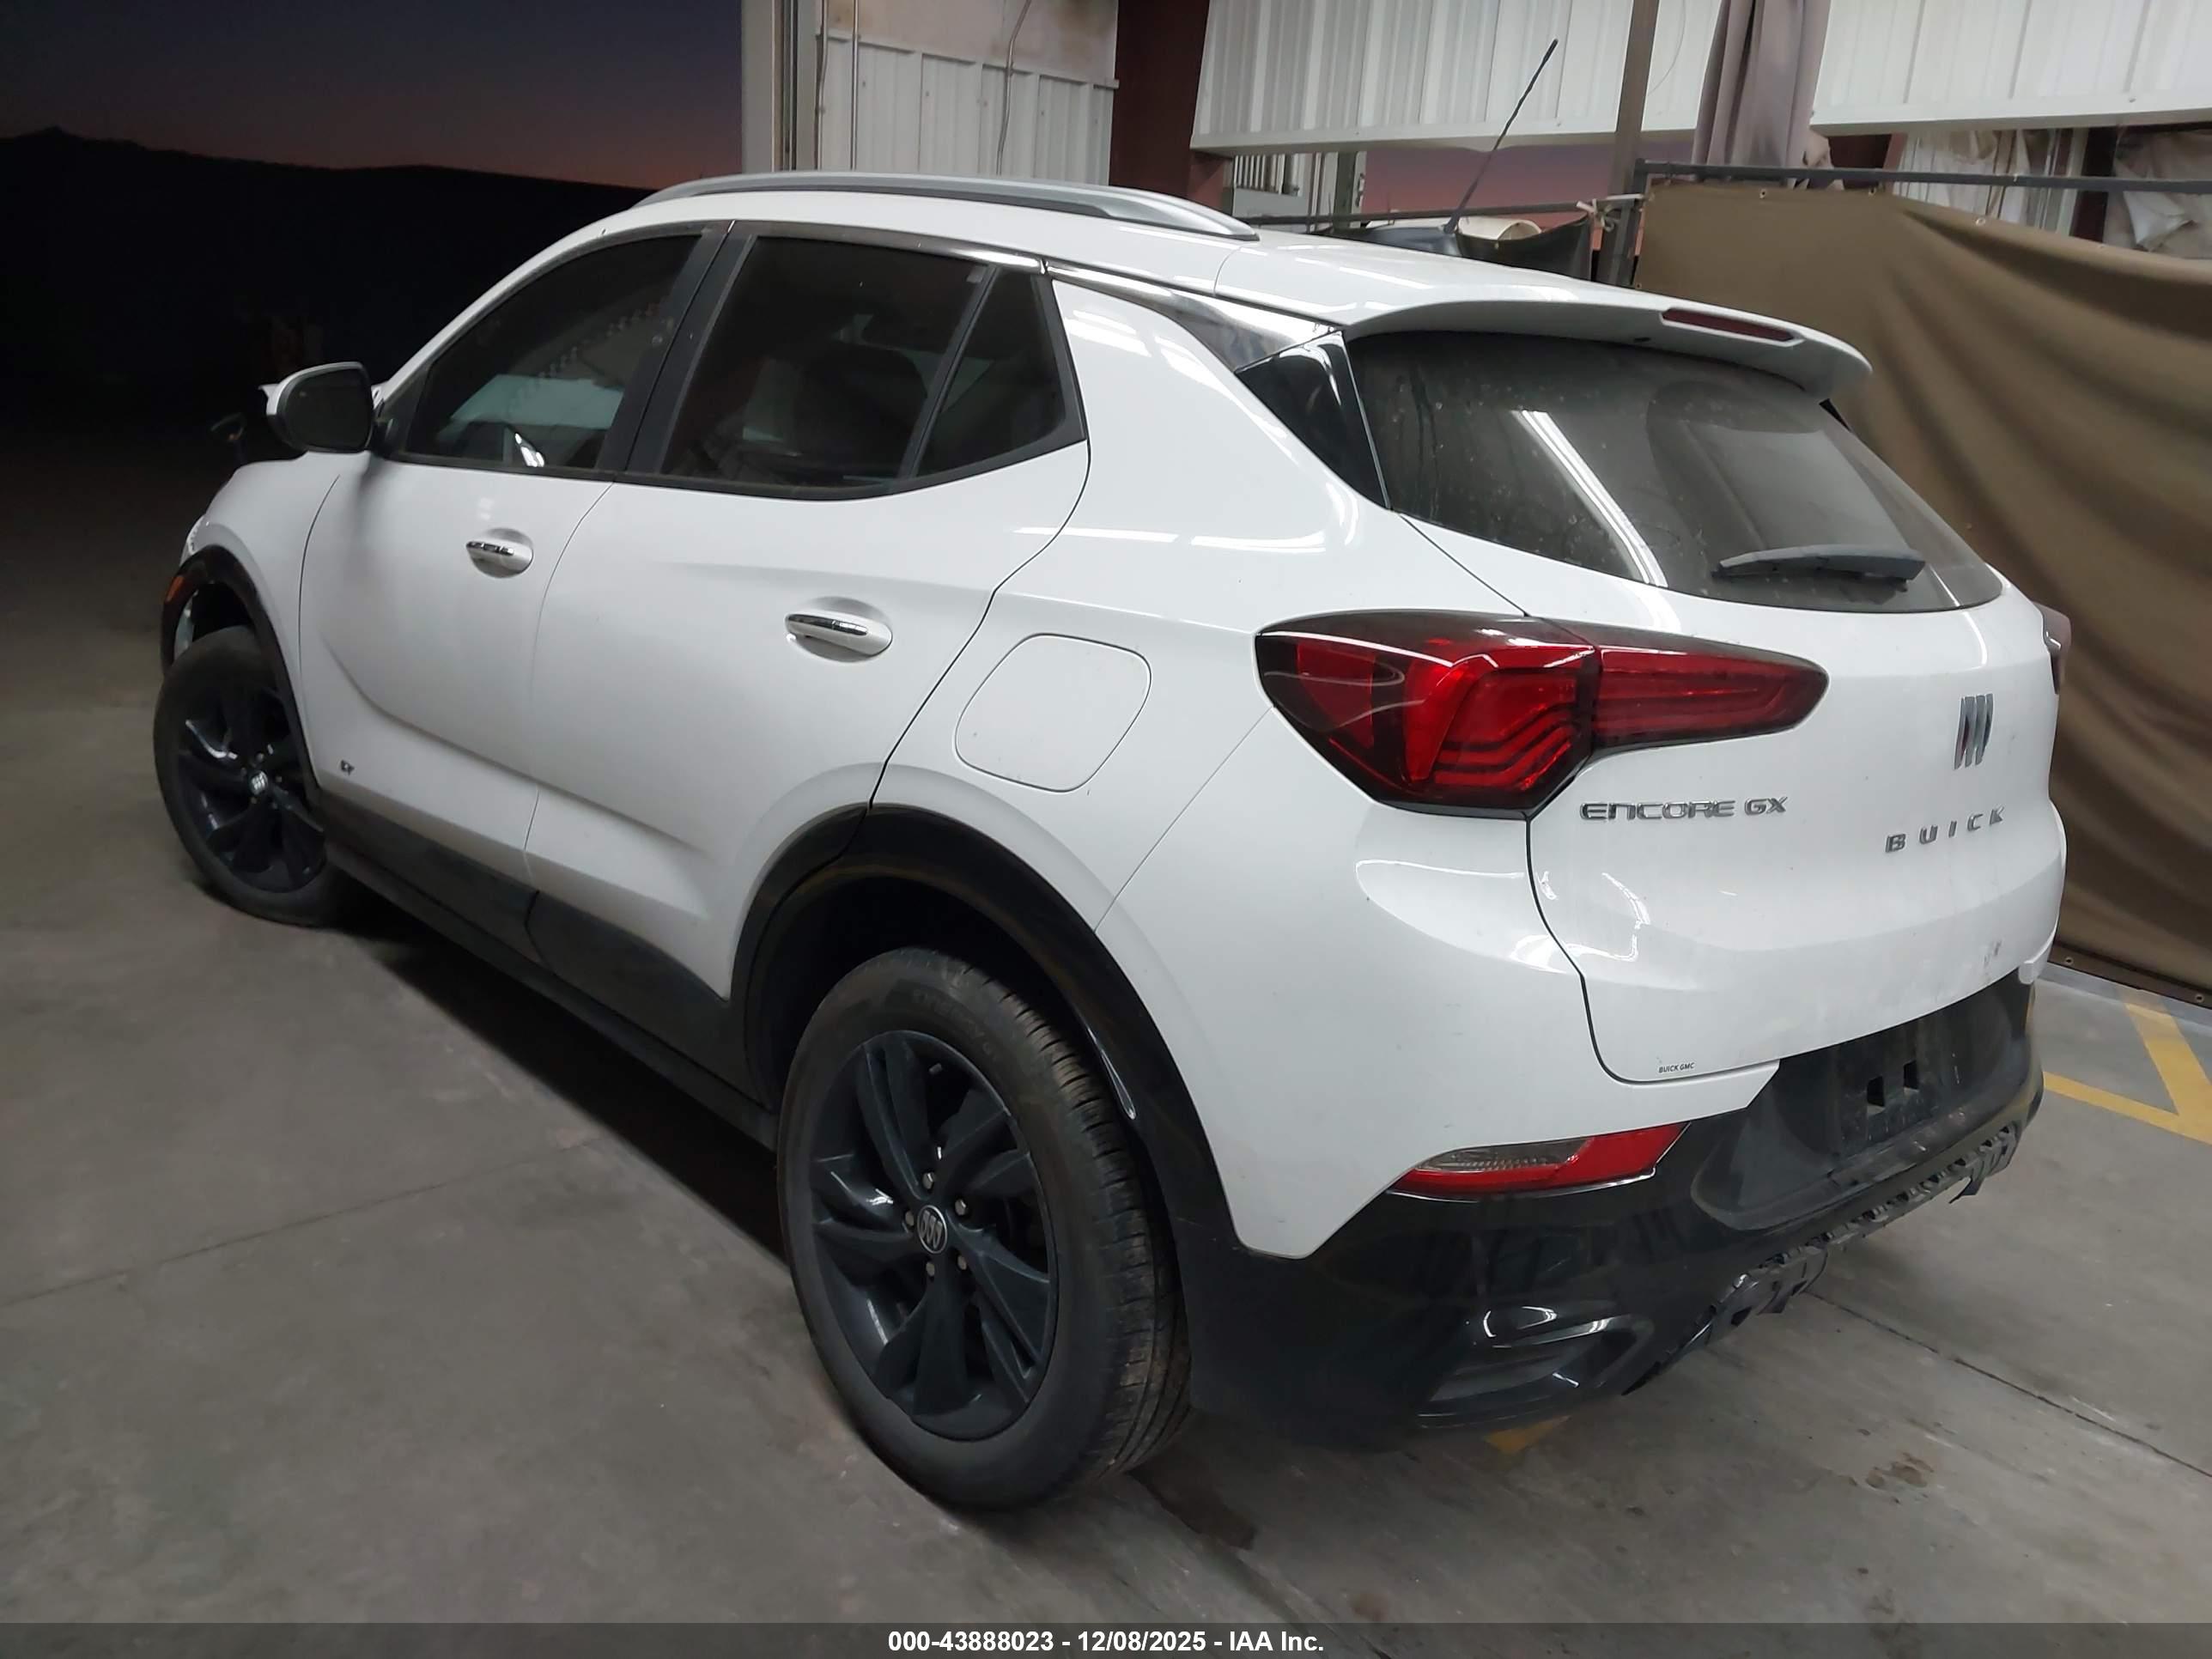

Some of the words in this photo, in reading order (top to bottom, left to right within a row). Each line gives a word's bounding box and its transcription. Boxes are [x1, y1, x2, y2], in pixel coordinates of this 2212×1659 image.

[1580, 799, 1735, 821] ENCORE
[1744, 795, 1788, 817] GX
[1885, 806, 2005, 854] BUICK
[1658, 1065, 1680, 1073] BUICK
[1680, 1062, 1695, 1071] GMC
